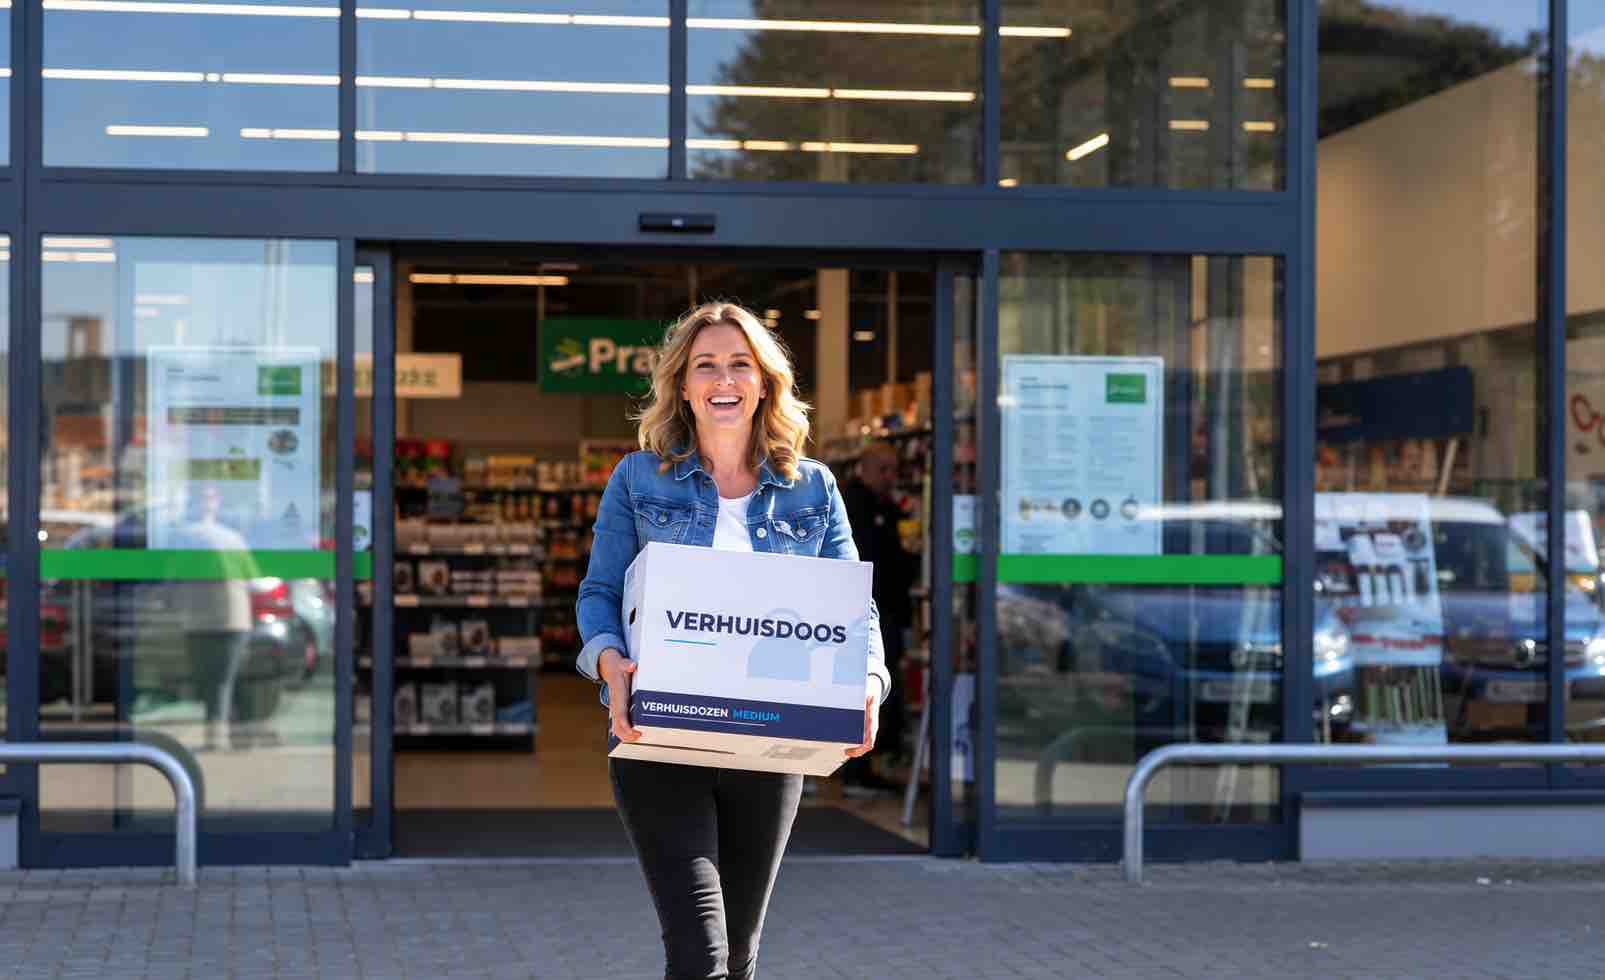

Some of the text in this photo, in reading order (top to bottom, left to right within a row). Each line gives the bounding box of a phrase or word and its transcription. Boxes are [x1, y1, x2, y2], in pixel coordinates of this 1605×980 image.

[589, 337, 655, 374] Pra
[666, 610, 847, 644] VERHUISDOOS
[641, 701, 781, 722] VERHUISDOZEN MEDIUM
